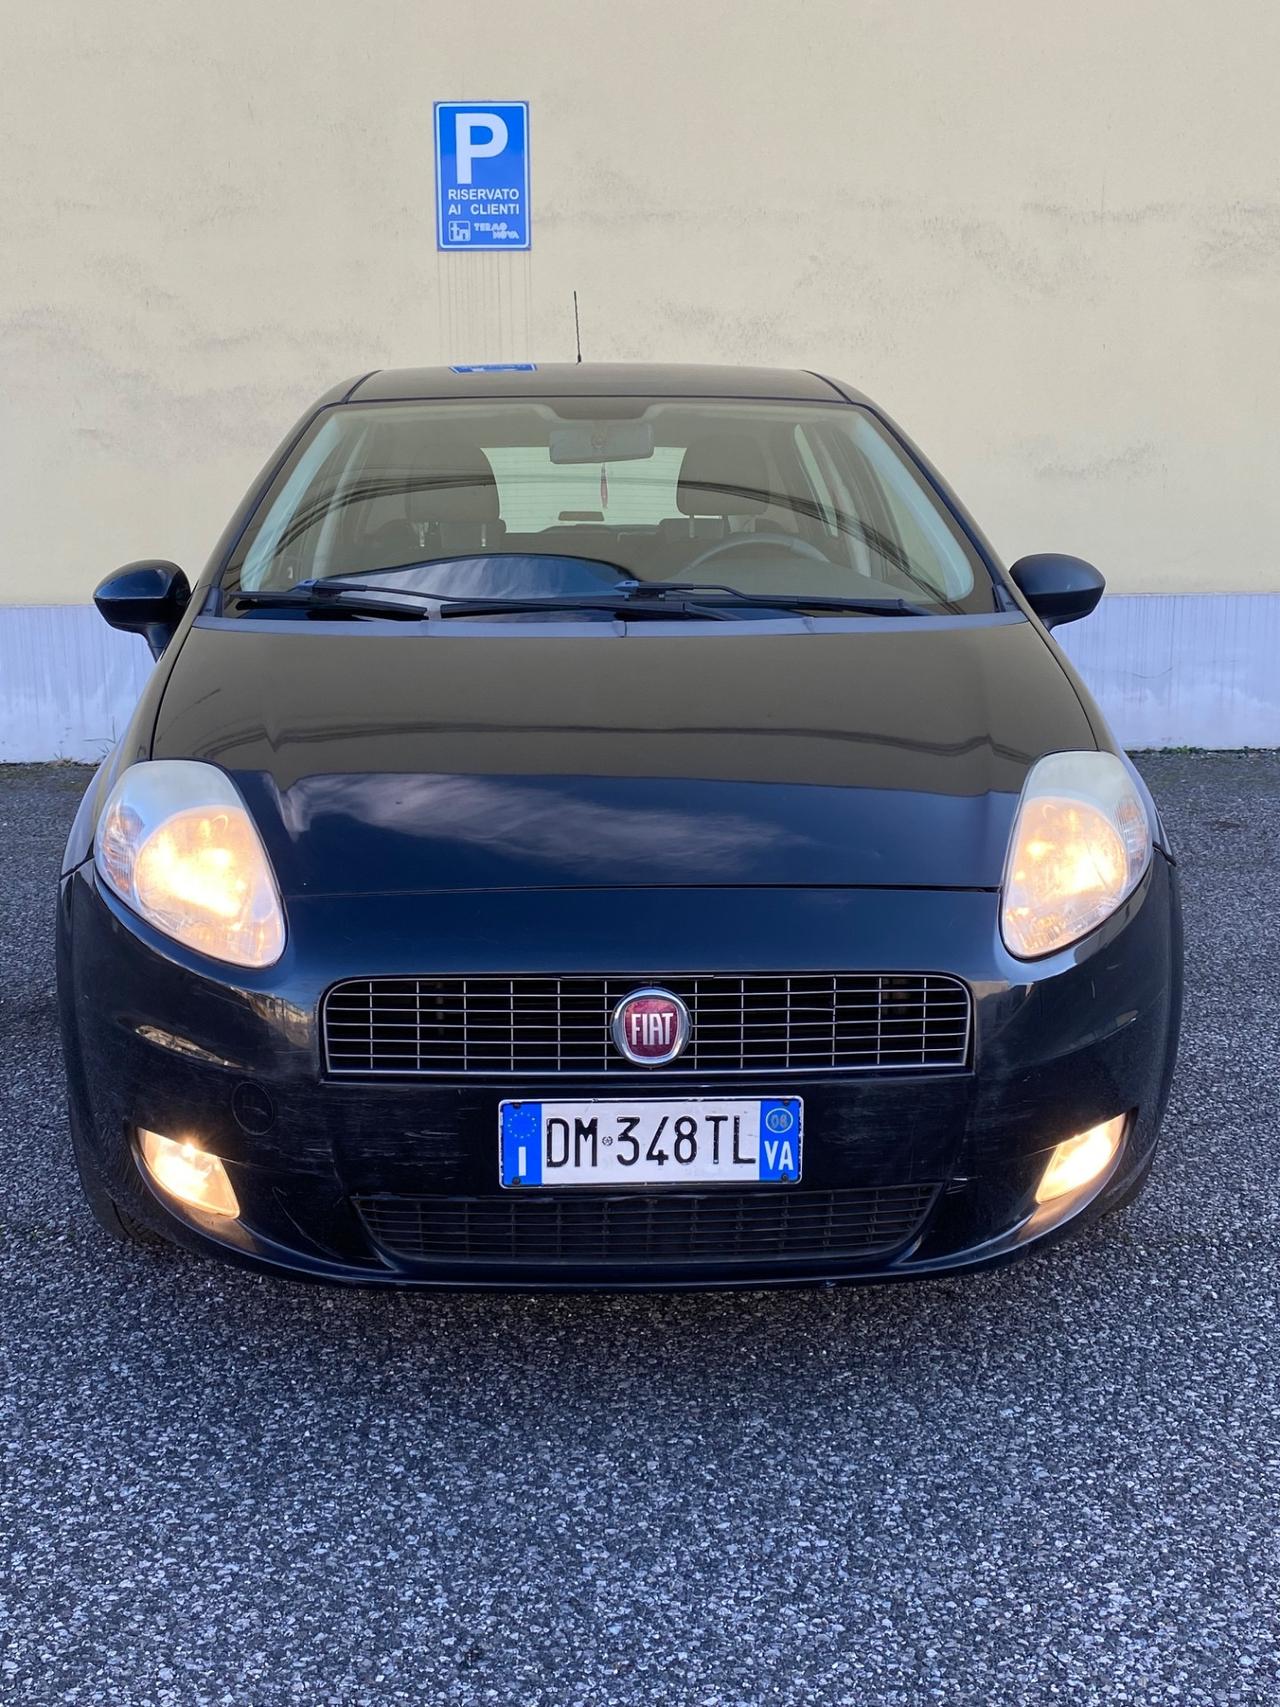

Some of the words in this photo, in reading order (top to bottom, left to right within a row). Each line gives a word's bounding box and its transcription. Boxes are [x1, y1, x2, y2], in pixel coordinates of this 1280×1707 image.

[455, 112, 508, 184] P
[448, 188, 519, 200] RISERVATO
[448, 204, 461, 215] AI
[470, 203, 519, 215] CLIENTI
[631, 1012, 673, 1045] FIAT
[764, 1140, 794, 1171] VA
